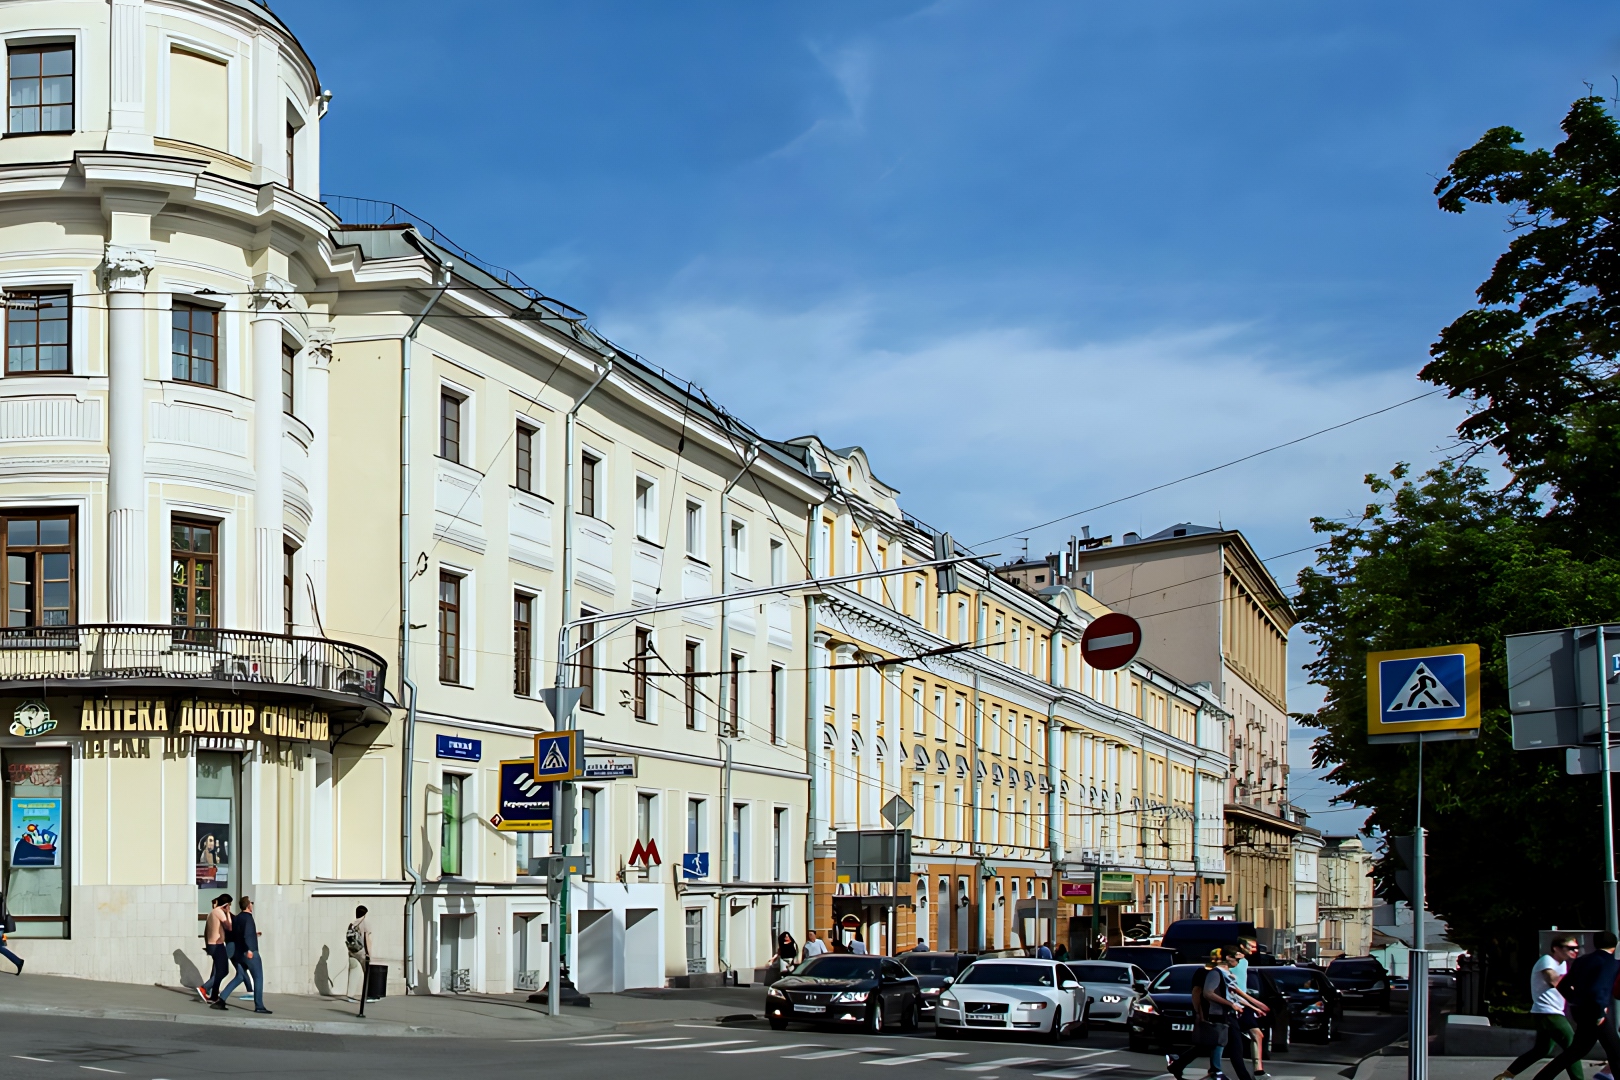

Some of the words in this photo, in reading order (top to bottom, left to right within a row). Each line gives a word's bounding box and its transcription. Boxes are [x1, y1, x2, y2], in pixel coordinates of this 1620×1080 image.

[80, 698, 169, 731] АПТЕКА
[179, 700, 255, 735] ДОКТОР
[260, 704, 329, 741] СТОЛЕТОВ
[628, 837, 662, 867] М
